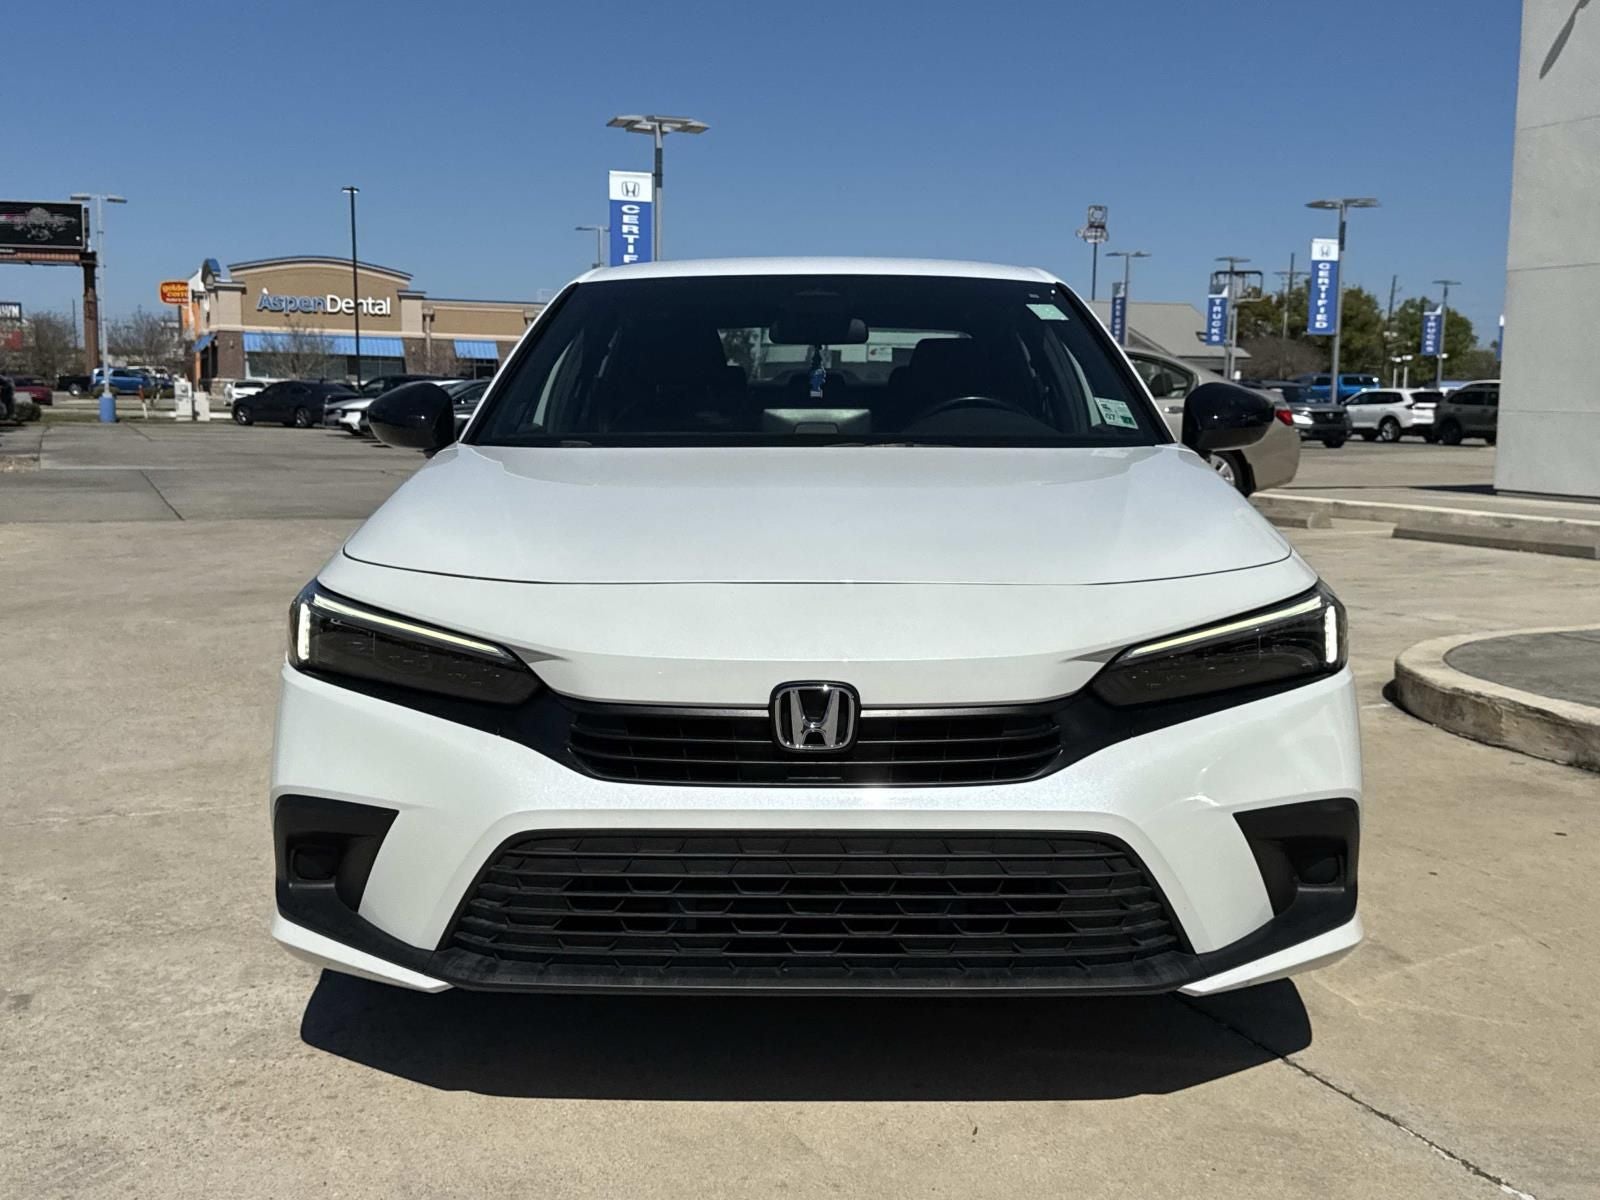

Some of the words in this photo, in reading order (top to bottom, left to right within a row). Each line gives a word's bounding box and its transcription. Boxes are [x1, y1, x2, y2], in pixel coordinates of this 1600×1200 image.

[621, 204, 641, 263] CERTIF
[1211, 299, 1221, 342] TRUCKS
[1315, 262, 1331, 328] CERTIFIED
